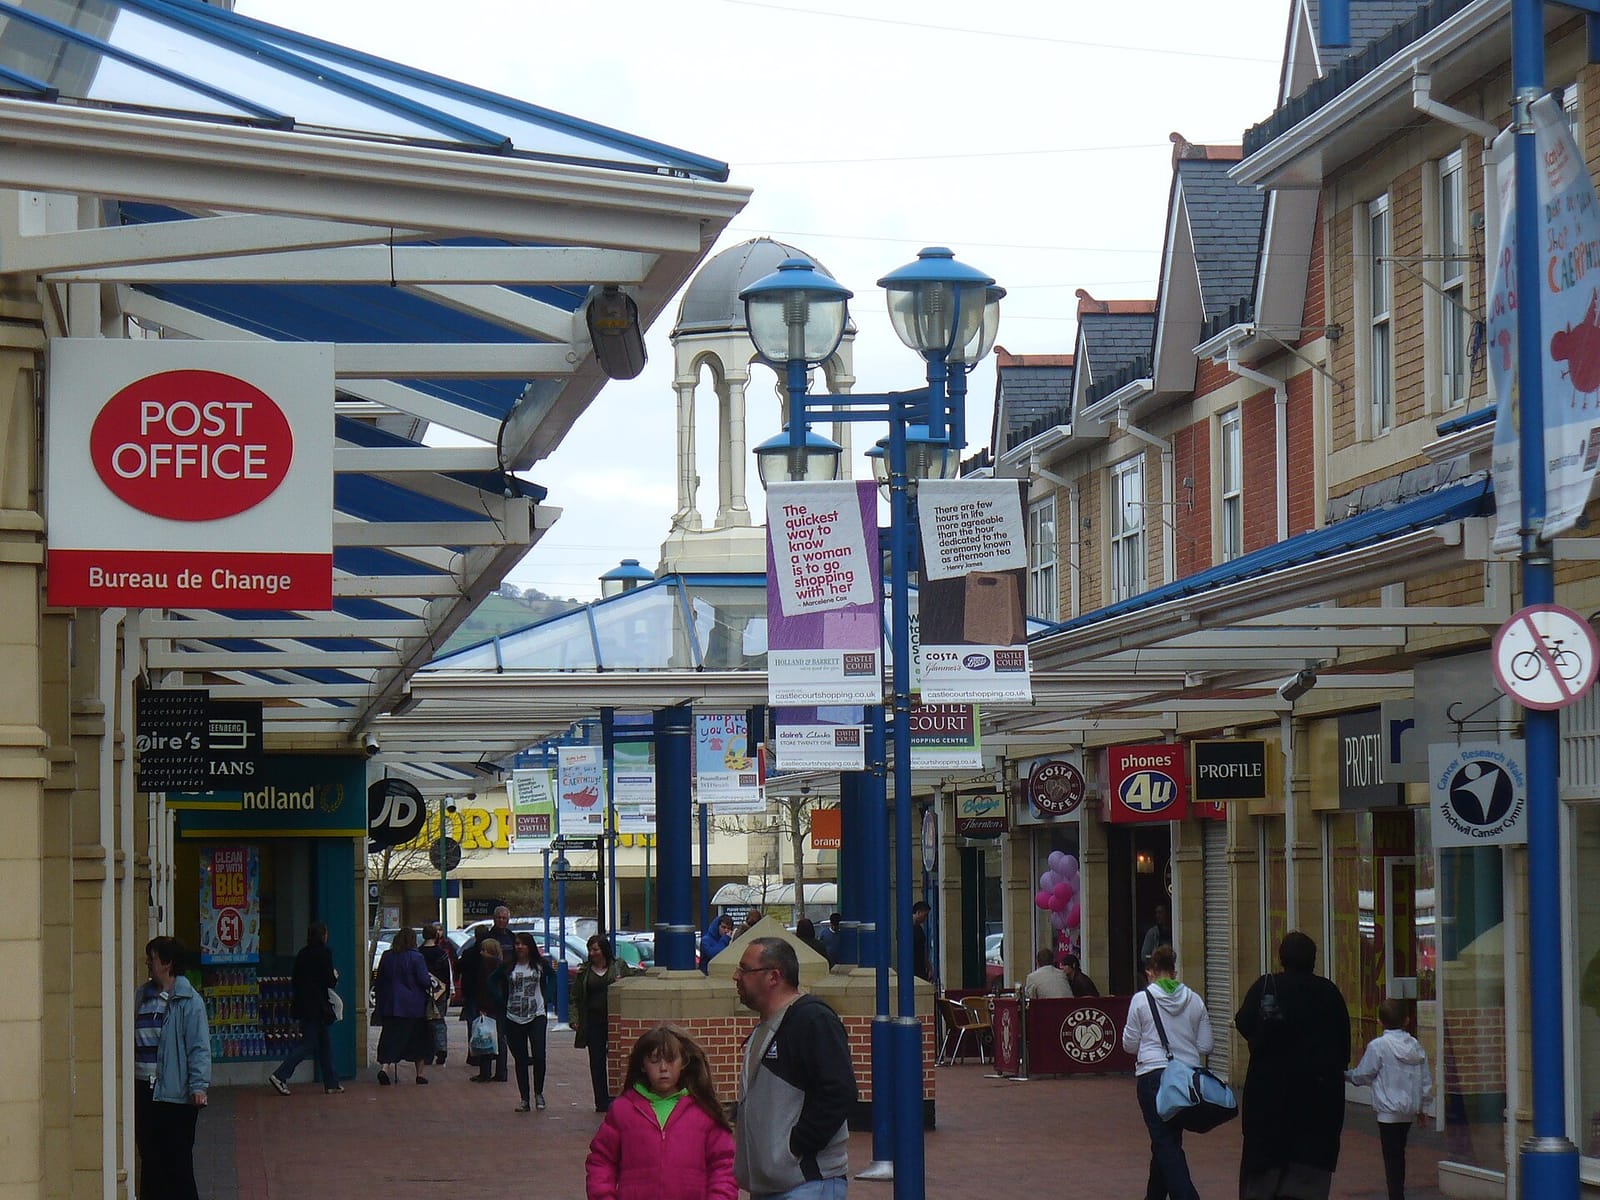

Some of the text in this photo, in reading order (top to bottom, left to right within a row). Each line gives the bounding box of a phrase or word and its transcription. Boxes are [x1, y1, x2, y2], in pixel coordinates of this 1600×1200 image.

[141, 400, 252, 437] POST
[112, 443, 268, 479] OFFICE
[783, 504, 807, 517] The
[934, 501, 993, 515] There are few
[785, 510, 839, 531] quickest
[935, 510, 984, 523] hours in life
[936, 515, 1004, 531] more agreeable
[787, 525, 831, 540] way to
[937, 525, 995, 539] than the hour
[938, 530, 1007, 548] dedicated to the
[788, 539, 824, 552] know
[940, 540, 1011, 556] ceremony known
[791, 546, 852, 564] a woman
[941, 547, 1011, 564] as afternoon tea
[792, 561, 840, 576] is to go
[89, 567, 291, 593] Bureau de Change
[794, 570, 854, 588] shopping
[796, 583, 853, 600] with her
[926, 652, 958, 661] COSTA
[996, 651, 1024, 659] CASTLE
[996, 658, 1024, 666] COURT
[846, 662, 873, 670] COURT
[775, 691, 876, 701] castlecourtshopping.co.uk
[927, 690, 1026, 699] castlecourtshopping.co.uk
[209, 761, 255, 775] IANS
[1121, 754, 1172, 770] phones
[1039, 766, 1073, 781] COSTA
[1198, 763, 1262, 779] PROFILE
[1437, 750, 1524, 791] Cancer Research Wales
[243, 787, 315, 811] ndland
[1125, 773, 1172, 810] 4u
[1038, 792, 1078, 810] COFFEE
[371, 796, 417, 829] JD
[1440, 798, 1525, 838] Ymchwil Canser Cymru
[813, 837, 841, 847] orang
[215, 851, 243, 864] CLEAN
[226, 863, 243, 873] WITH
[215, 872, 244, 896] BIG
[220, 916, 239, 941] £1
[1067, 1009, 1106, 1027] COSTA
[1065, 1040, 1112, 1061] COFFEE
